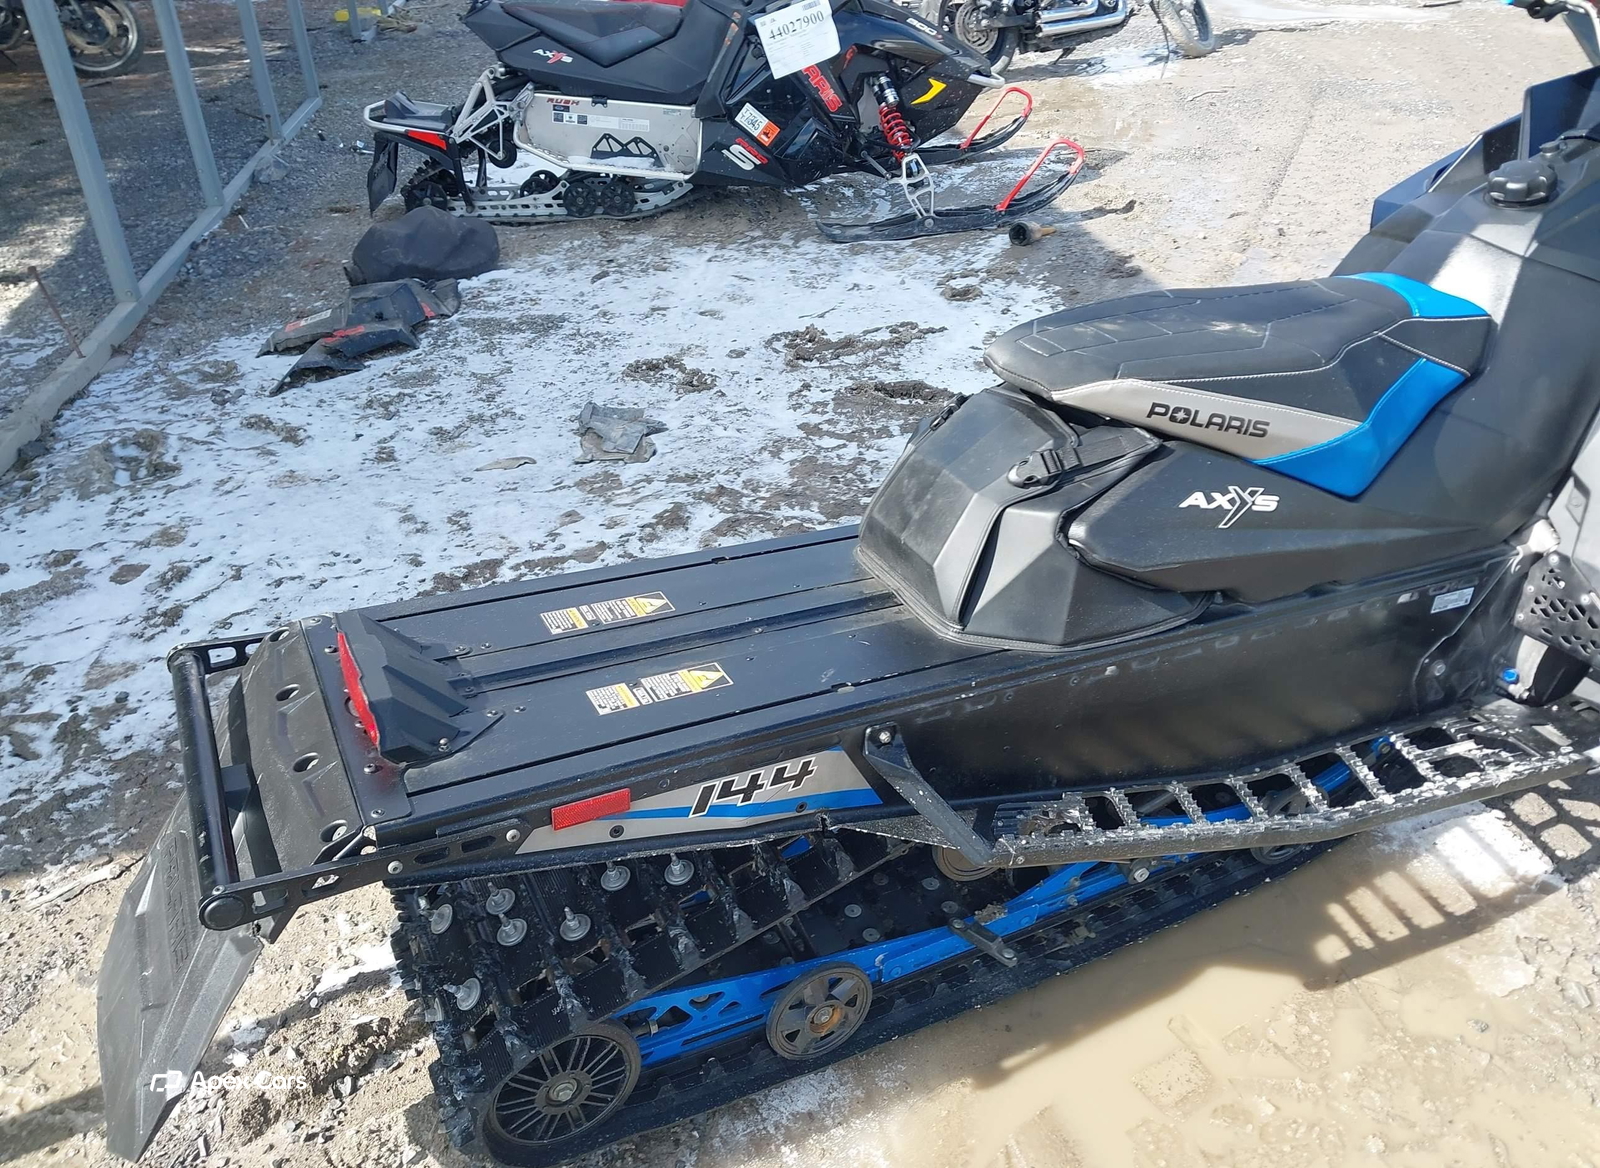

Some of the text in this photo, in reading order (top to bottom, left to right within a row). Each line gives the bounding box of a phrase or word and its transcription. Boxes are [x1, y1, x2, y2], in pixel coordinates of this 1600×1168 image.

[769, 10, 825, 40] 44027900
[802, 64, 843, 112] ARIS
[1146, 401, 1271, 438] POLARIS
[1178, 485, 1280, 529] AXYS
[688, 757, 818, 818] 144
